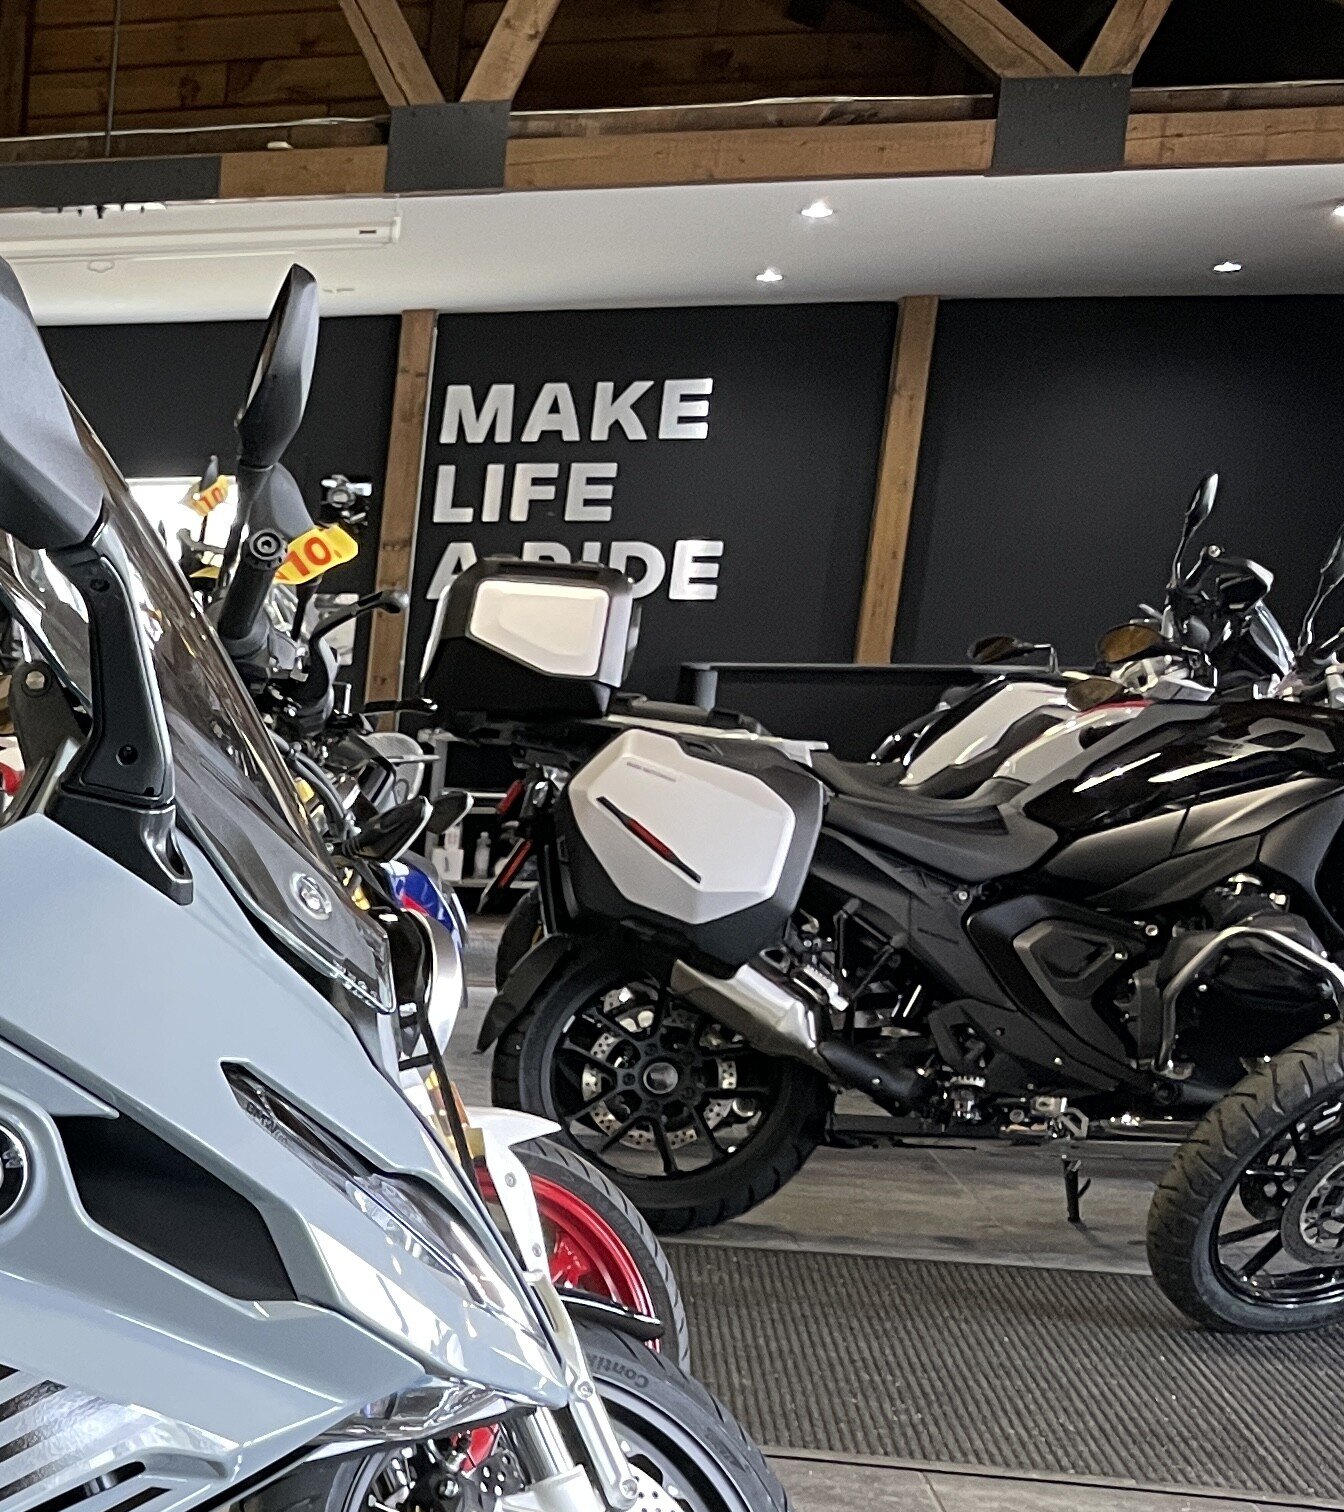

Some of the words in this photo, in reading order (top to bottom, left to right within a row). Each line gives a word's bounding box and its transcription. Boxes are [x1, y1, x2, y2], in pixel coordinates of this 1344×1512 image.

[439, 378, 713, 444] MAKE
[432, 462, 619, 523] LIFE
[426, 541, 478, 600] A
